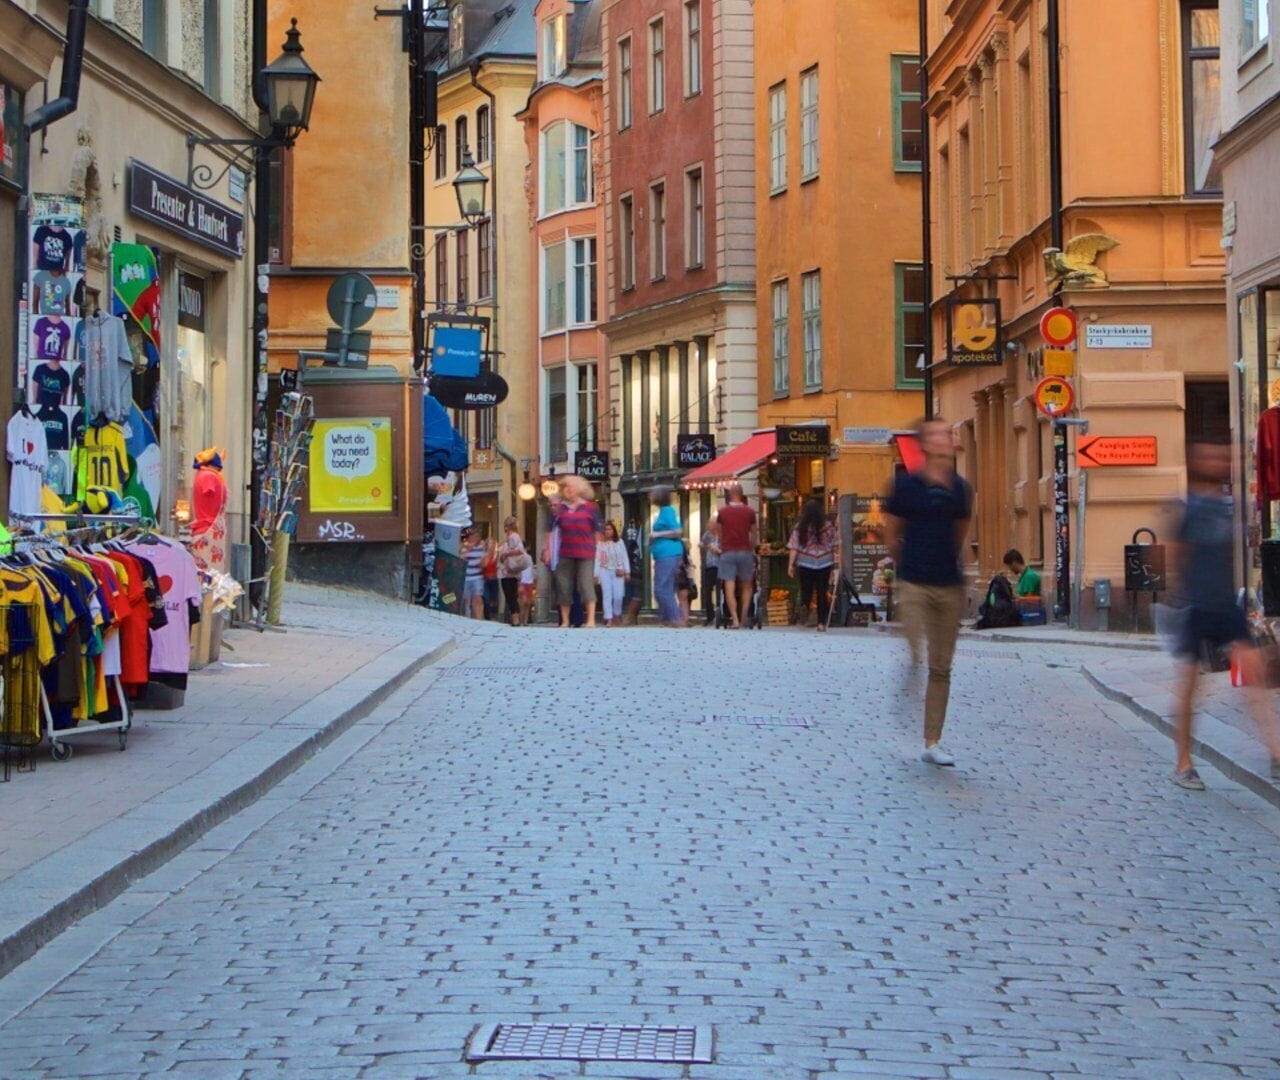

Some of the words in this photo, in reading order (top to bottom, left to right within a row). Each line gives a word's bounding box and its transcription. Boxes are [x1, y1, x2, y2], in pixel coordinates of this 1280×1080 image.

[951, 352, 998, 364] apoteket
[464, 392, 496, 402] MUREN
[330, 433, 353, 445] What
[353, 433, 366, 445] do
[331, 448, 347, 459] you
[348, 446, 370, 457] need
[680, 452, 713, 463] PALACE
[331, 457, 361, 471] today?
[577, 466, 607, 477] PALACE
